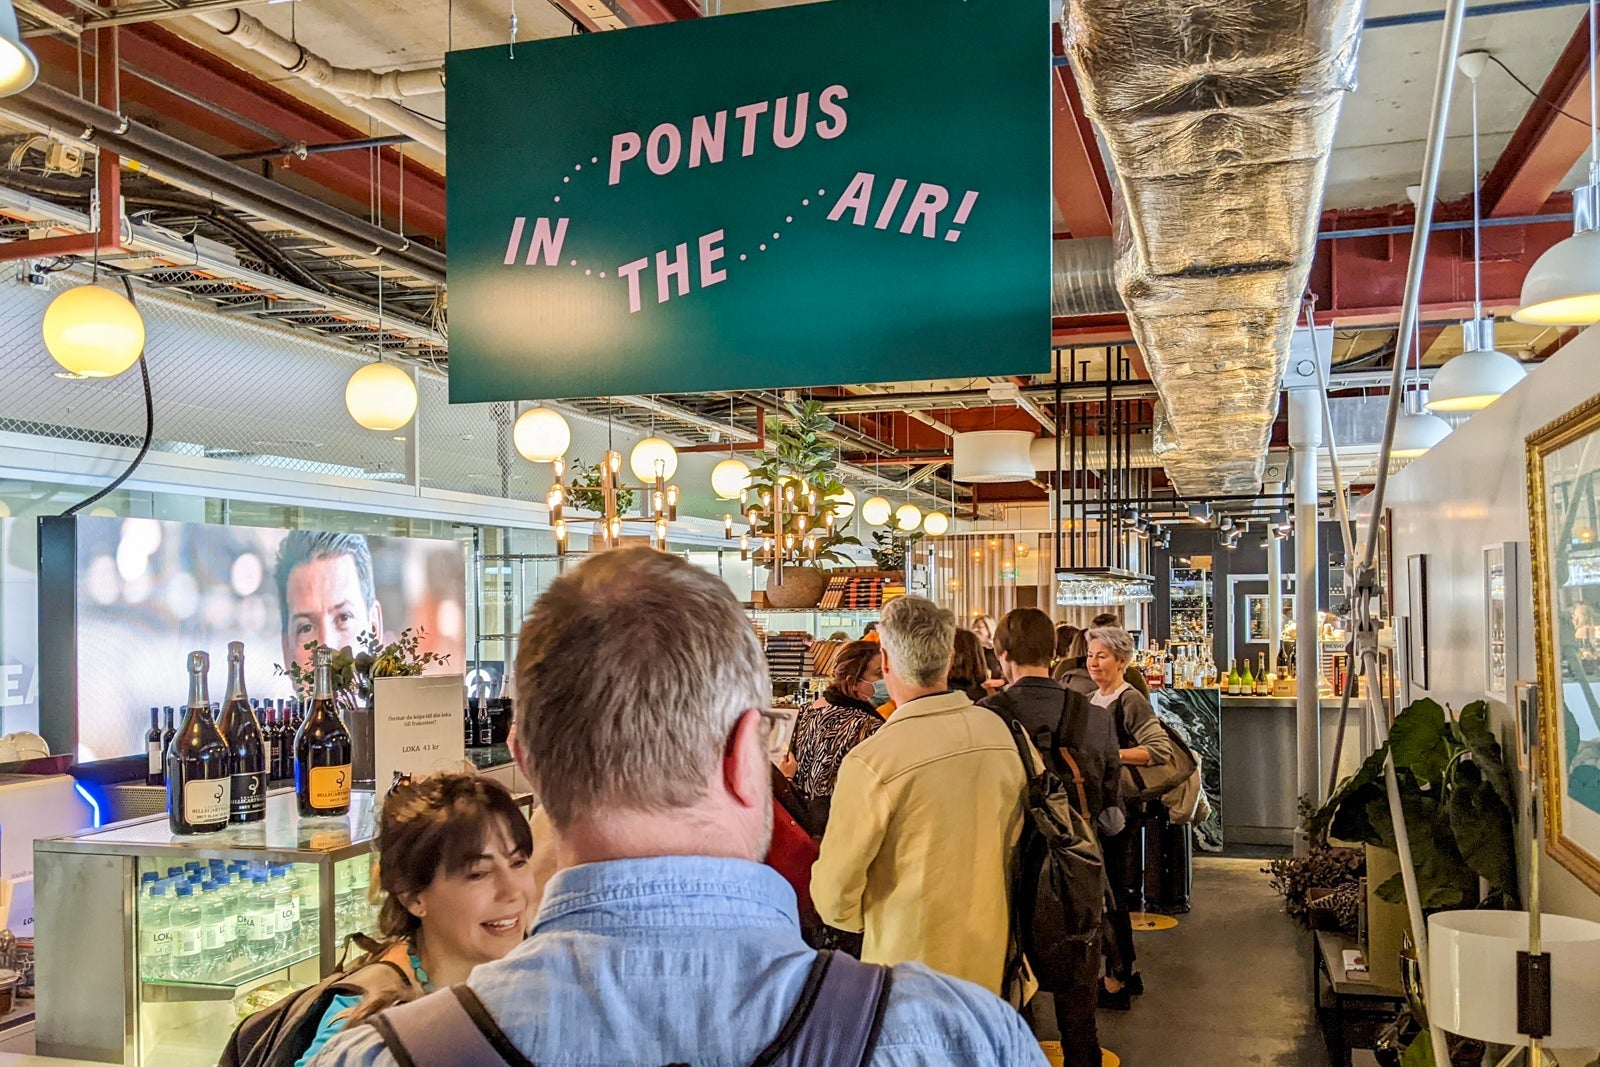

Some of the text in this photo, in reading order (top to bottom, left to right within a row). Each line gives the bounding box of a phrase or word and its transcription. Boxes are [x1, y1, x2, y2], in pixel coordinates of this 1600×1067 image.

[608, 85, 849, 186] PONTUS
[503, 217, 569, 267] IN
[826, 171, 979, 243] AIR!
[618, 228, 727, 314] THE
[402, 745, 420, 753] LOKA
